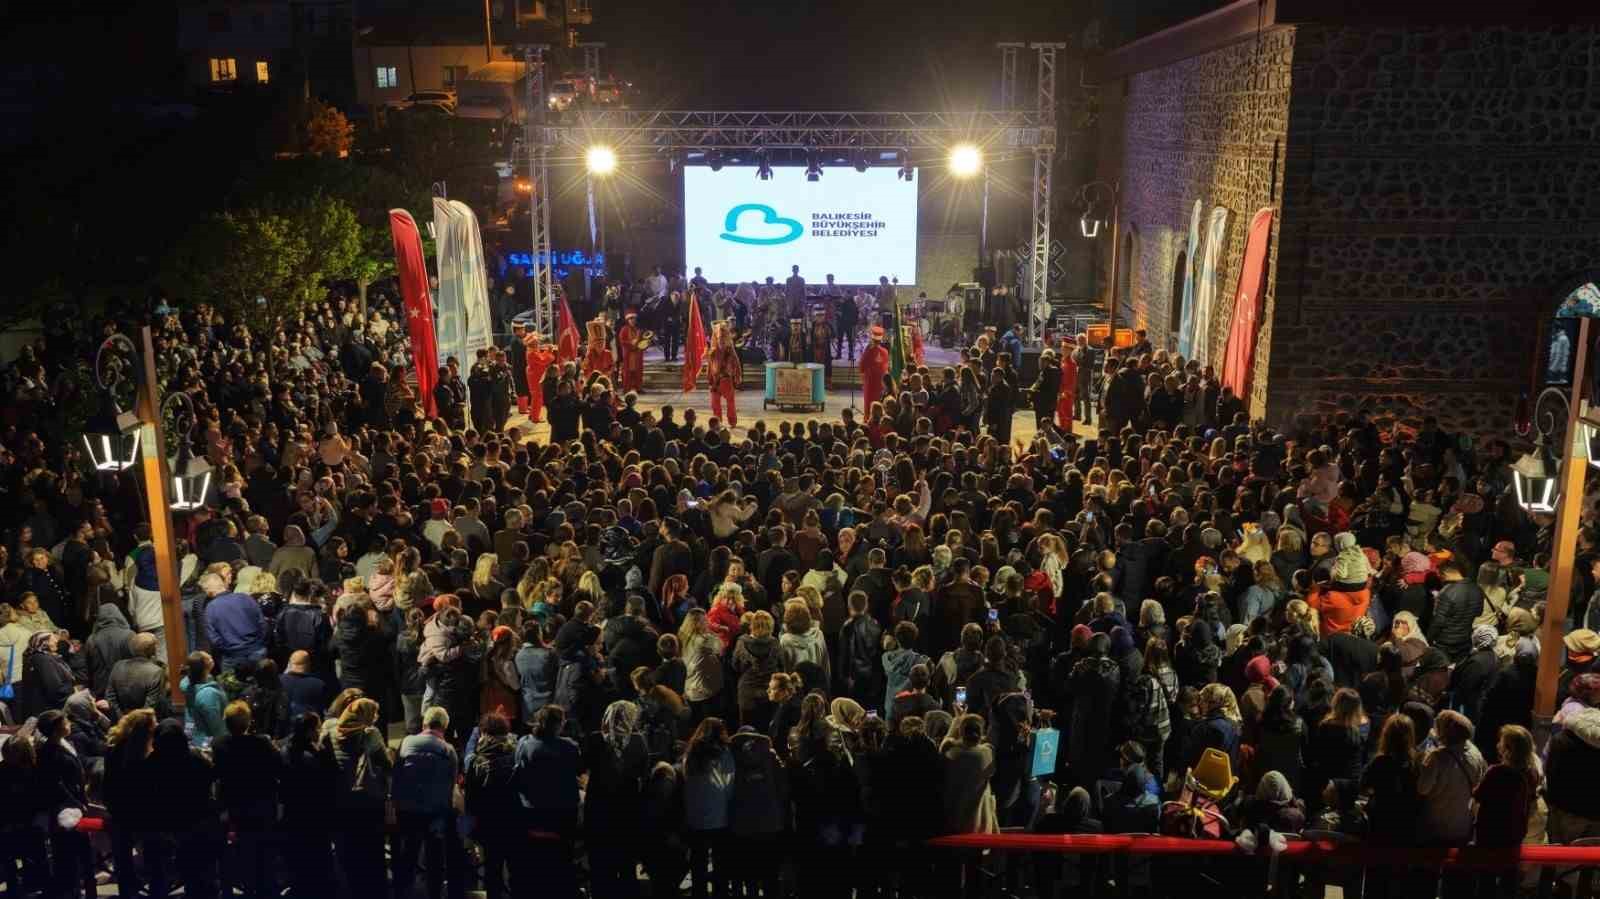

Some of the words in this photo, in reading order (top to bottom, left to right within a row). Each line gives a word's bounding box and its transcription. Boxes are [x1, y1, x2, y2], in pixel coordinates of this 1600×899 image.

[812, 212, 872, 220] BALIKESİR
[812, 220, 886, 229] BÜYÜKŞEHİR
[812, 229, 877, 237] BELEDİYESİ
